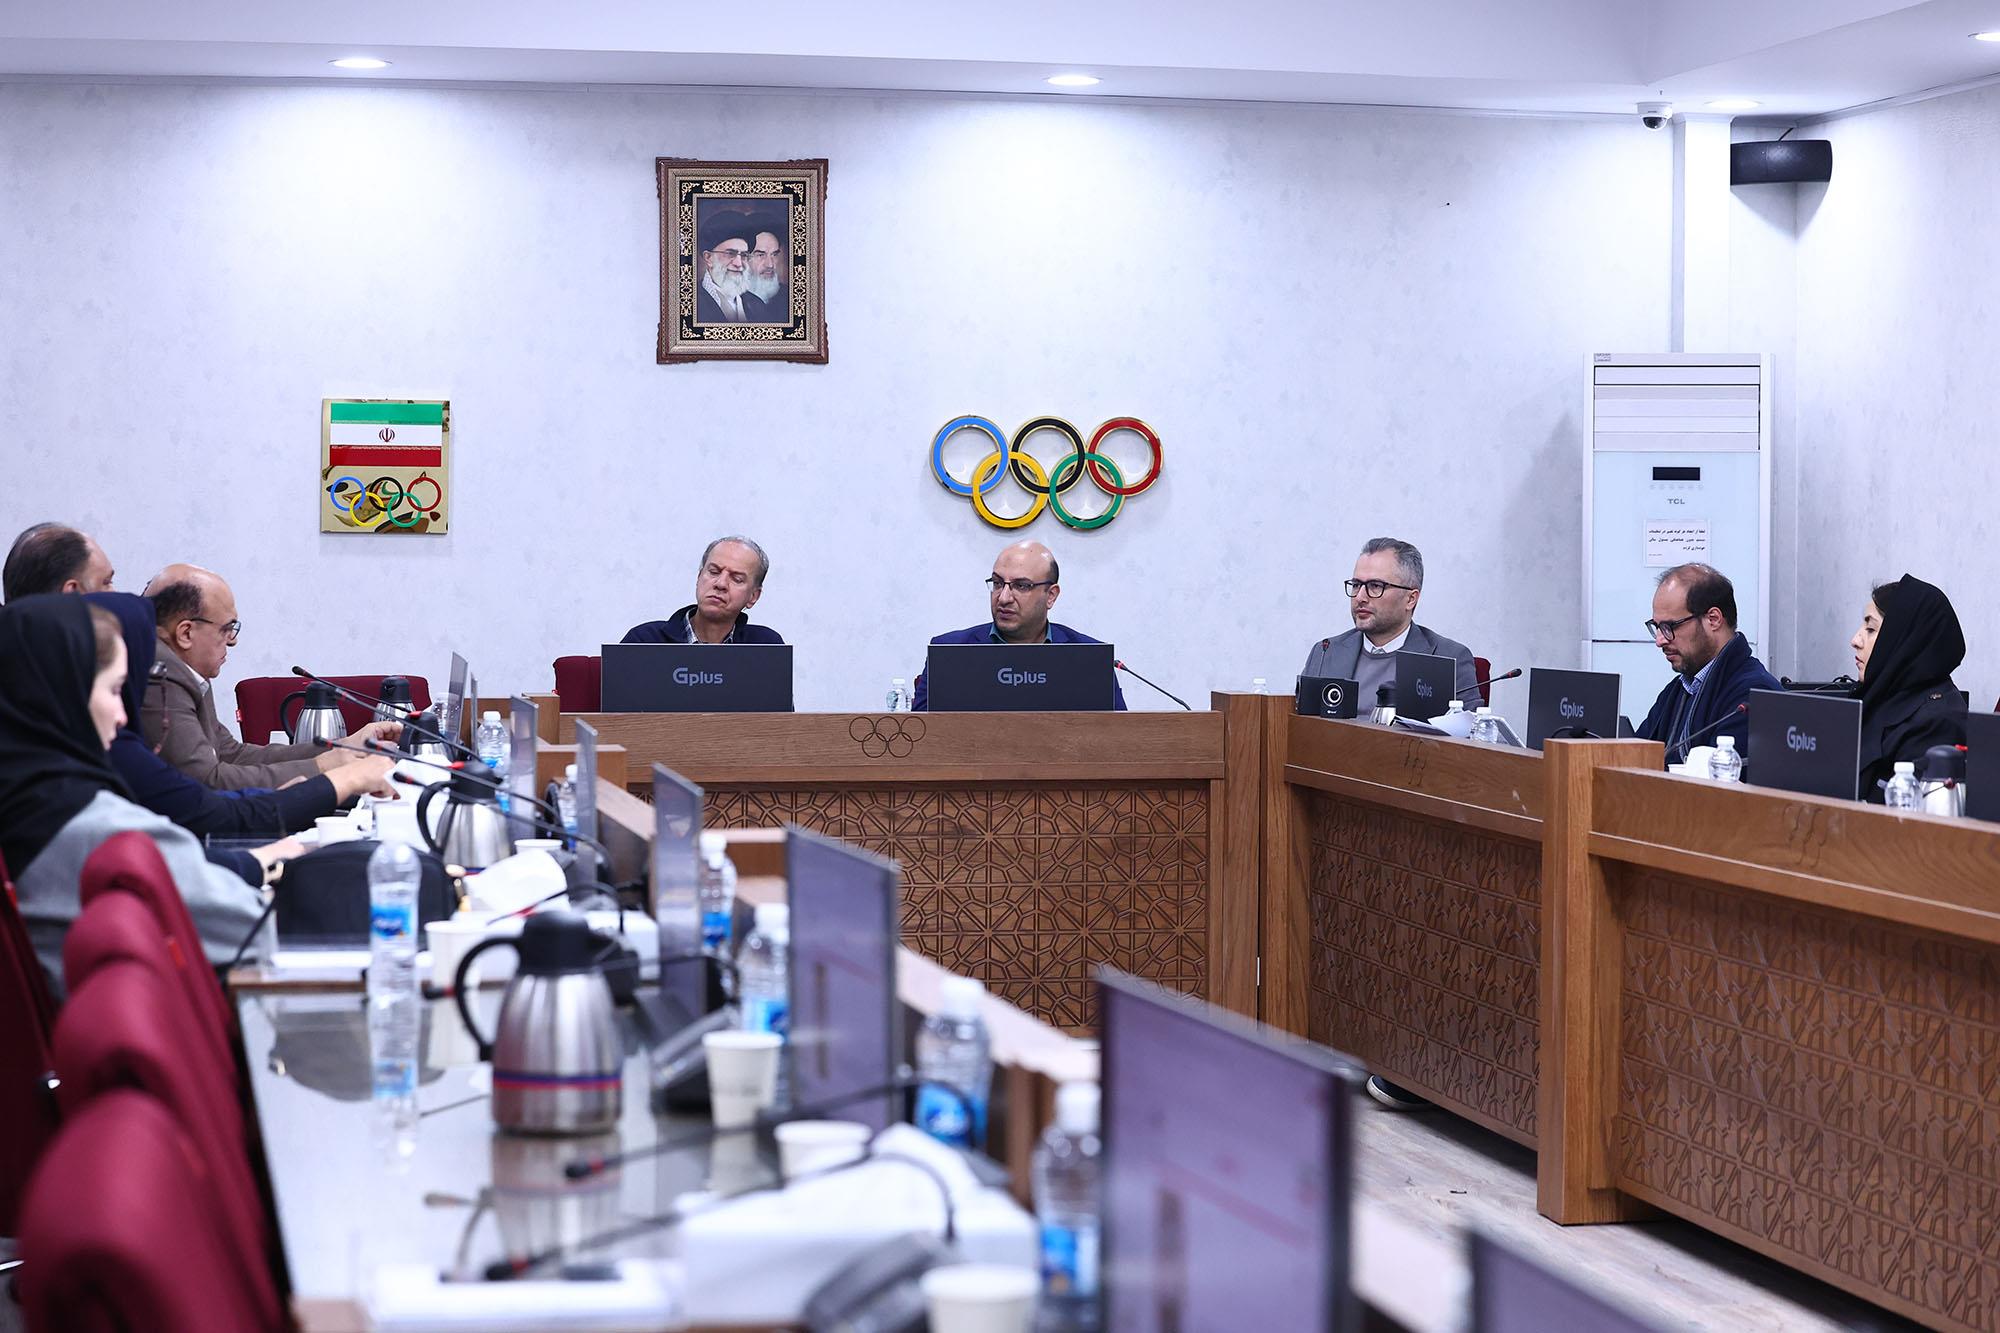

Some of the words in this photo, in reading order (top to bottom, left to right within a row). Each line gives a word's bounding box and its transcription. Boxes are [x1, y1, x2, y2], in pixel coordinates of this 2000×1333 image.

[672, 667, 724, 687] Gplus
[997, 667, 1047, 687] Gplus
[1415, 677, 1433, 699] Gplus
[1559, 696, 1585, 719] Gplus
[1786, 725, 1817, 752] Gplus
